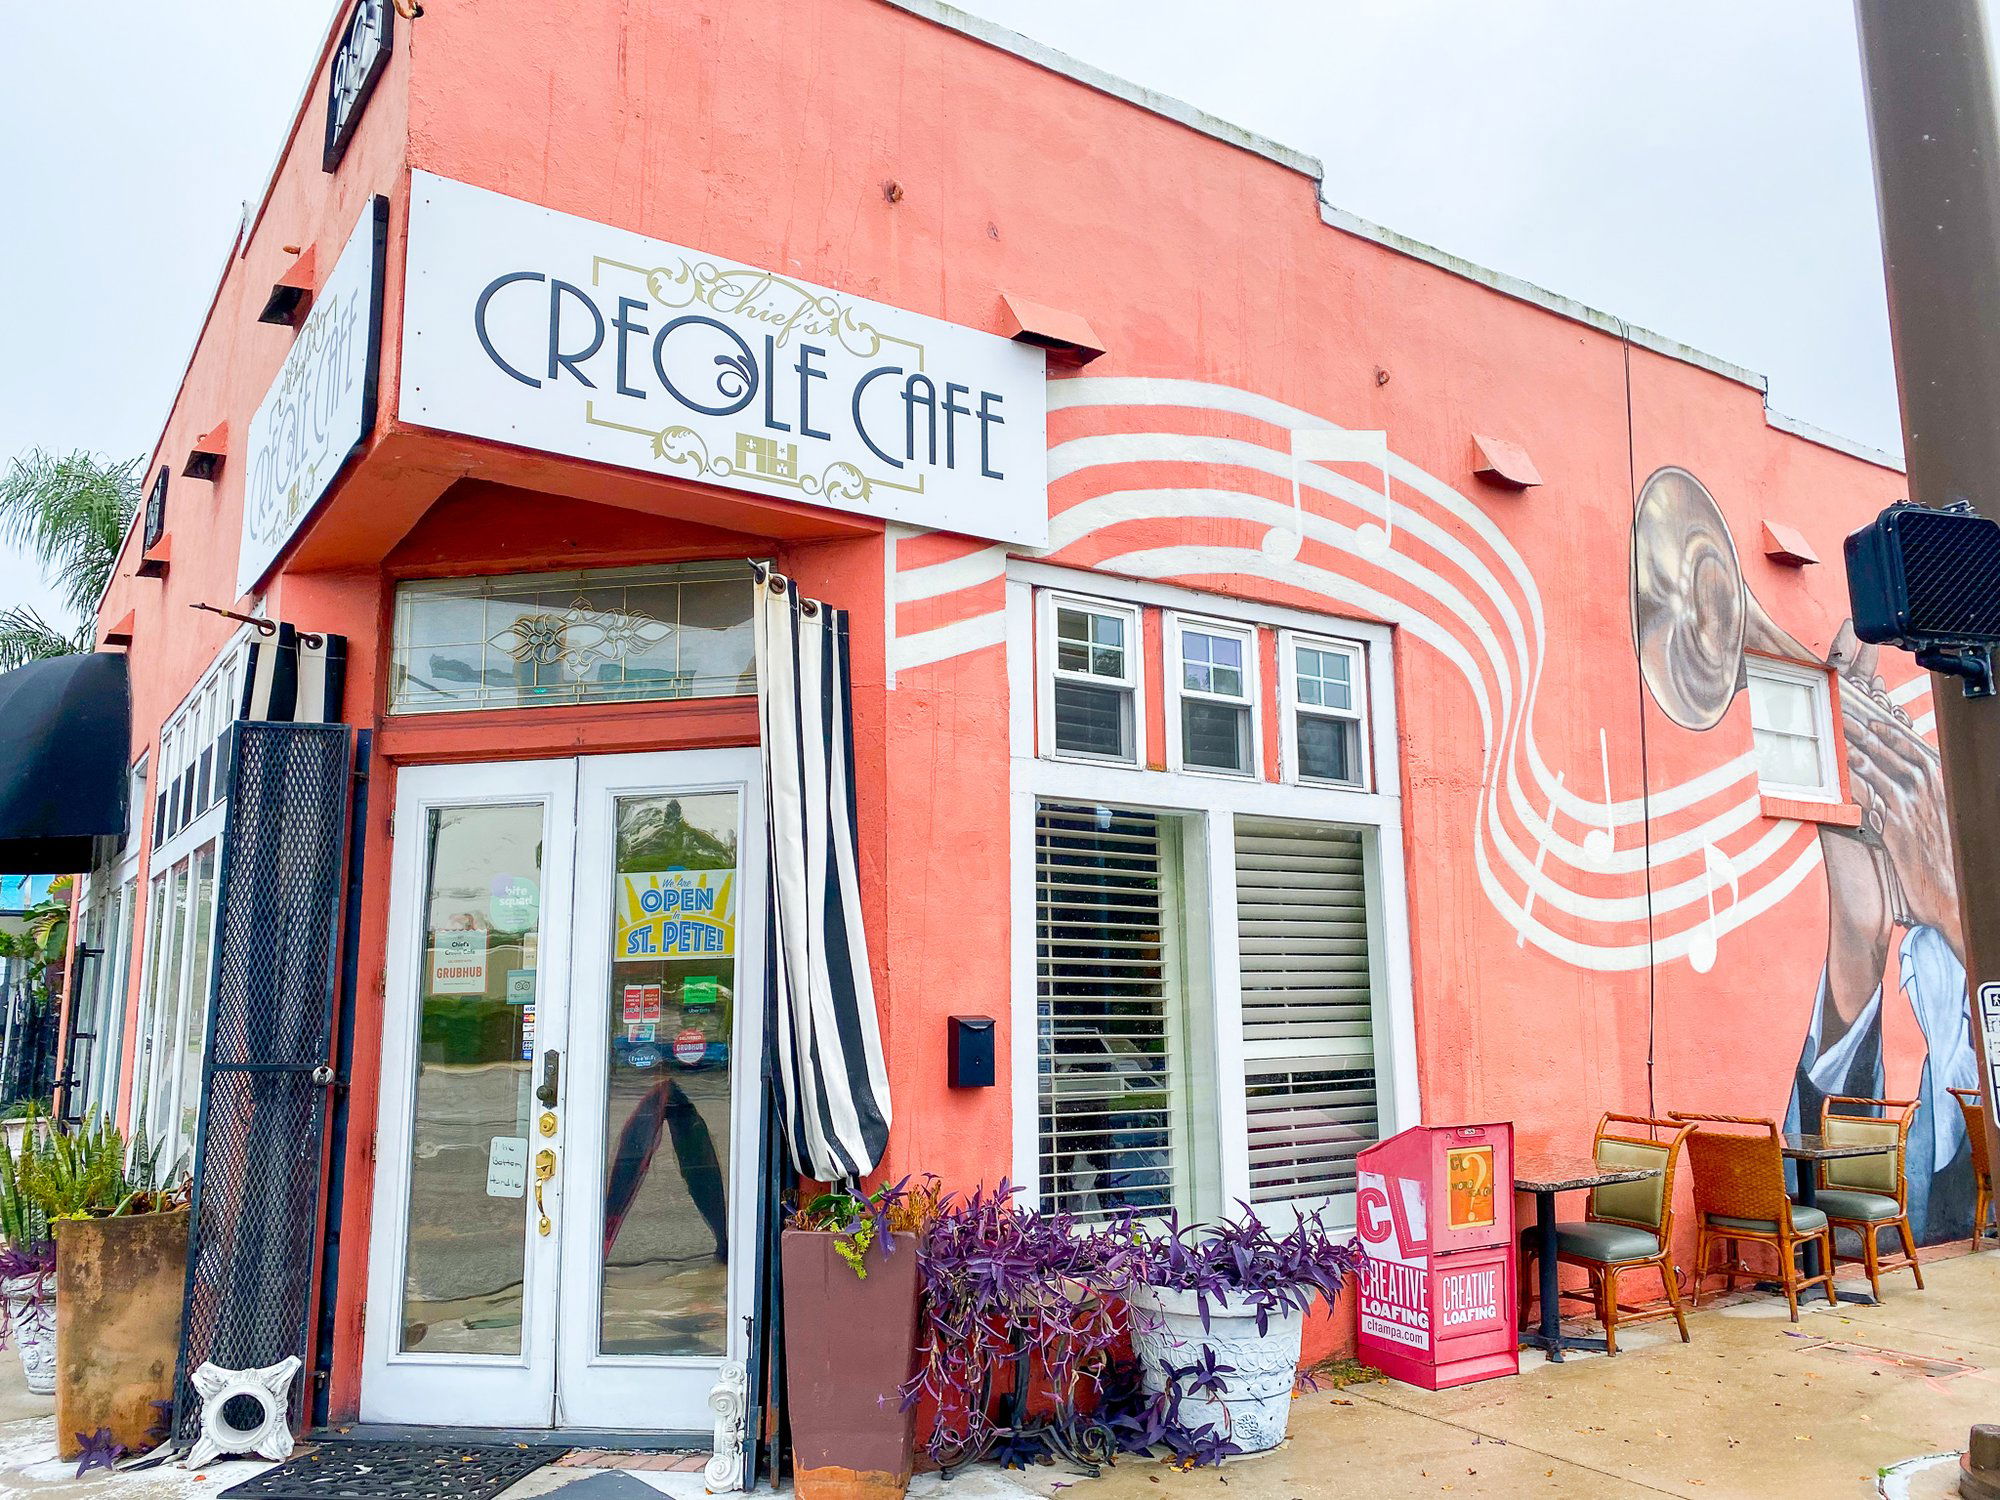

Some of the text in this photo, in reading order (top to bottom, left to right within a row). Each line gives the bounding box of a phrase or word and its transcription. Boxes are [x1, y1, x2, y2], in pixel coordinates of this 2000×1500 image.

[706, 276, 831, 349] Chief's
[475, 271, 831, 442] CREOLE
[852, 366, 1005, 481] CAFE
[250, 367, 312, 541] CREOLE
[313, 287, 359, 444] CAFE
[662, 877, 692, 888] We Are
[499, 895, 533, 908] squad
[640, 888, 714, 913] OPEN
[672, 910, 681, 920] In
[627, 921, 724, 954] ST. PETE!
[436, 966, 482, 979] GRUBHUB
[1357, 1175, 1428, 1259] CL
[1360, 1259, 1429, 1312] CREATIVE
[1442, 1270, 1496, 1312] CREATIVE
[1361, 1297, 1430, 1330] LOAFING
[1443, 1304, 1497, 1326] LOAFING
[1367, 1318, 1423, 1345] cltampa.com
